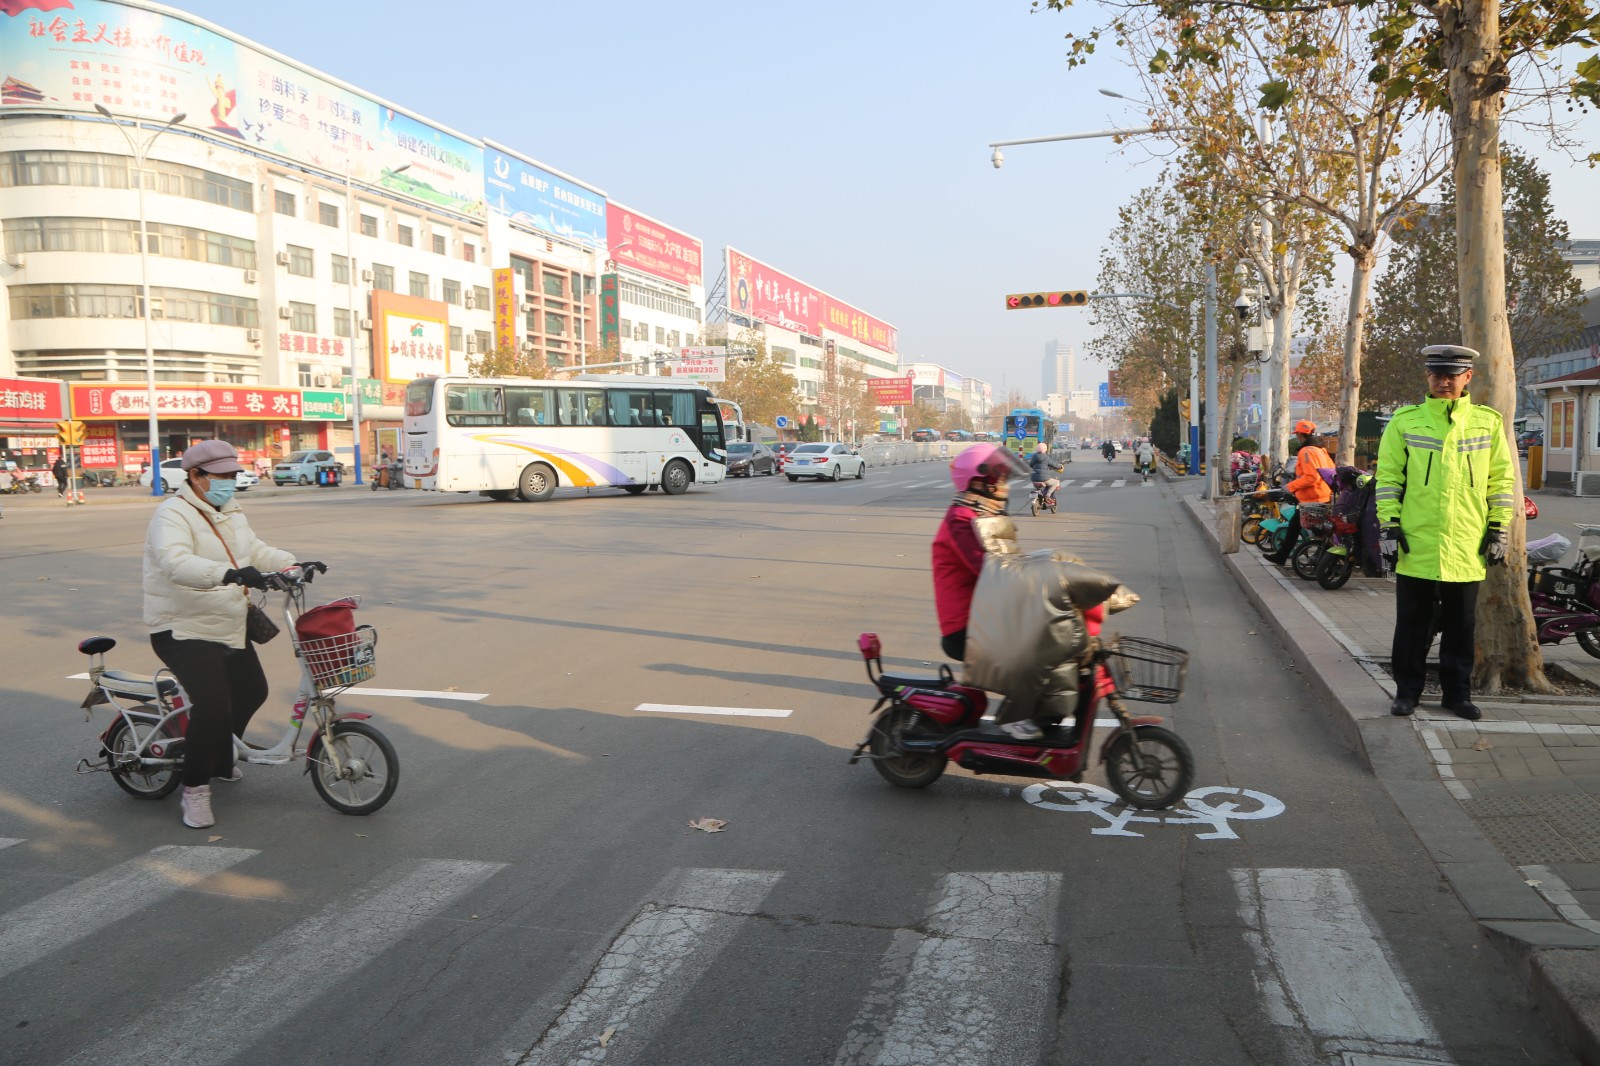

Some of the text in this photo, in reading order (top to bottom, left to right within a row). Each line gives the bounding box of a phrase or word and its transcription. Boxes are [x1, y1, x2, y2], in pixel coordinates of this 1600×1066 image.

[29, 16, 206, 67] 社会主义核心价值观
[70, 60, 91, 71] 富强
[100, 63, 121, 73] 民主
[160, 73, 176, 85] 和谐
[71, 76, 177, 100] 自由 平等 公正 法治
[258, 70, 362, 126] 崇尚科学 反对邪教
[72, 91, 93, 102] 爱国
[102, 94, 123, 105] 敬业
[161, 104, 177, 115] 友善
[259, 97, 362, 150] 珍爱生命 共享和谐
[398, 131, 471, 173] 创建全国文明城市
[390, 339, 443, 361] 如悦商务宾馆
[676, 366, 719, 374] 最高保障230万
[245, 392, 299, 417] 客欢 超市
[83, 455, 117, 464] 德州扒鸡
